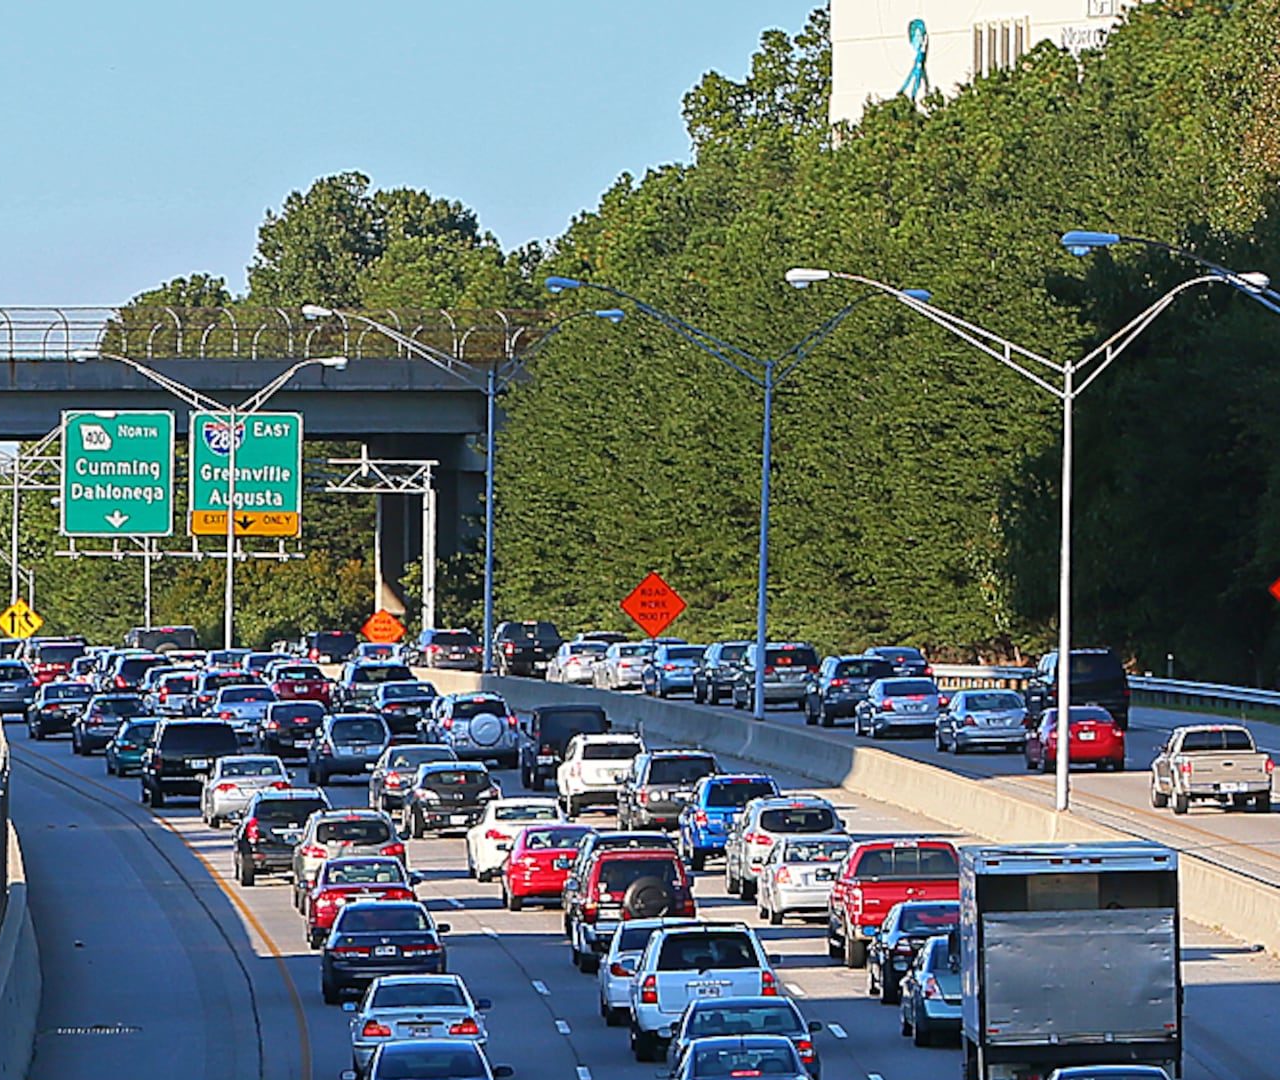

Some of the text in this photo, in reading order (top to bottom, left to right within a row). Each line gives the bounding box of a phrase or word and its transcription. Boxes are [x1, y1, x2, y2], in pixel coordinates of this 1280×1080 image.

[86, 425, 158, 445] 400 NORTH
[253, 421, 290, 437] EAST
[75, 457, 160, 480] Cumming
[200, 463, 291, 482] Greenville
[71, 482, 164, 505] Dahlonega
[208, 488, 283, 509] Augusta
[203, 514, 292, 525] EXIT ONLY
[640, 588, 668, 597] ROAD
